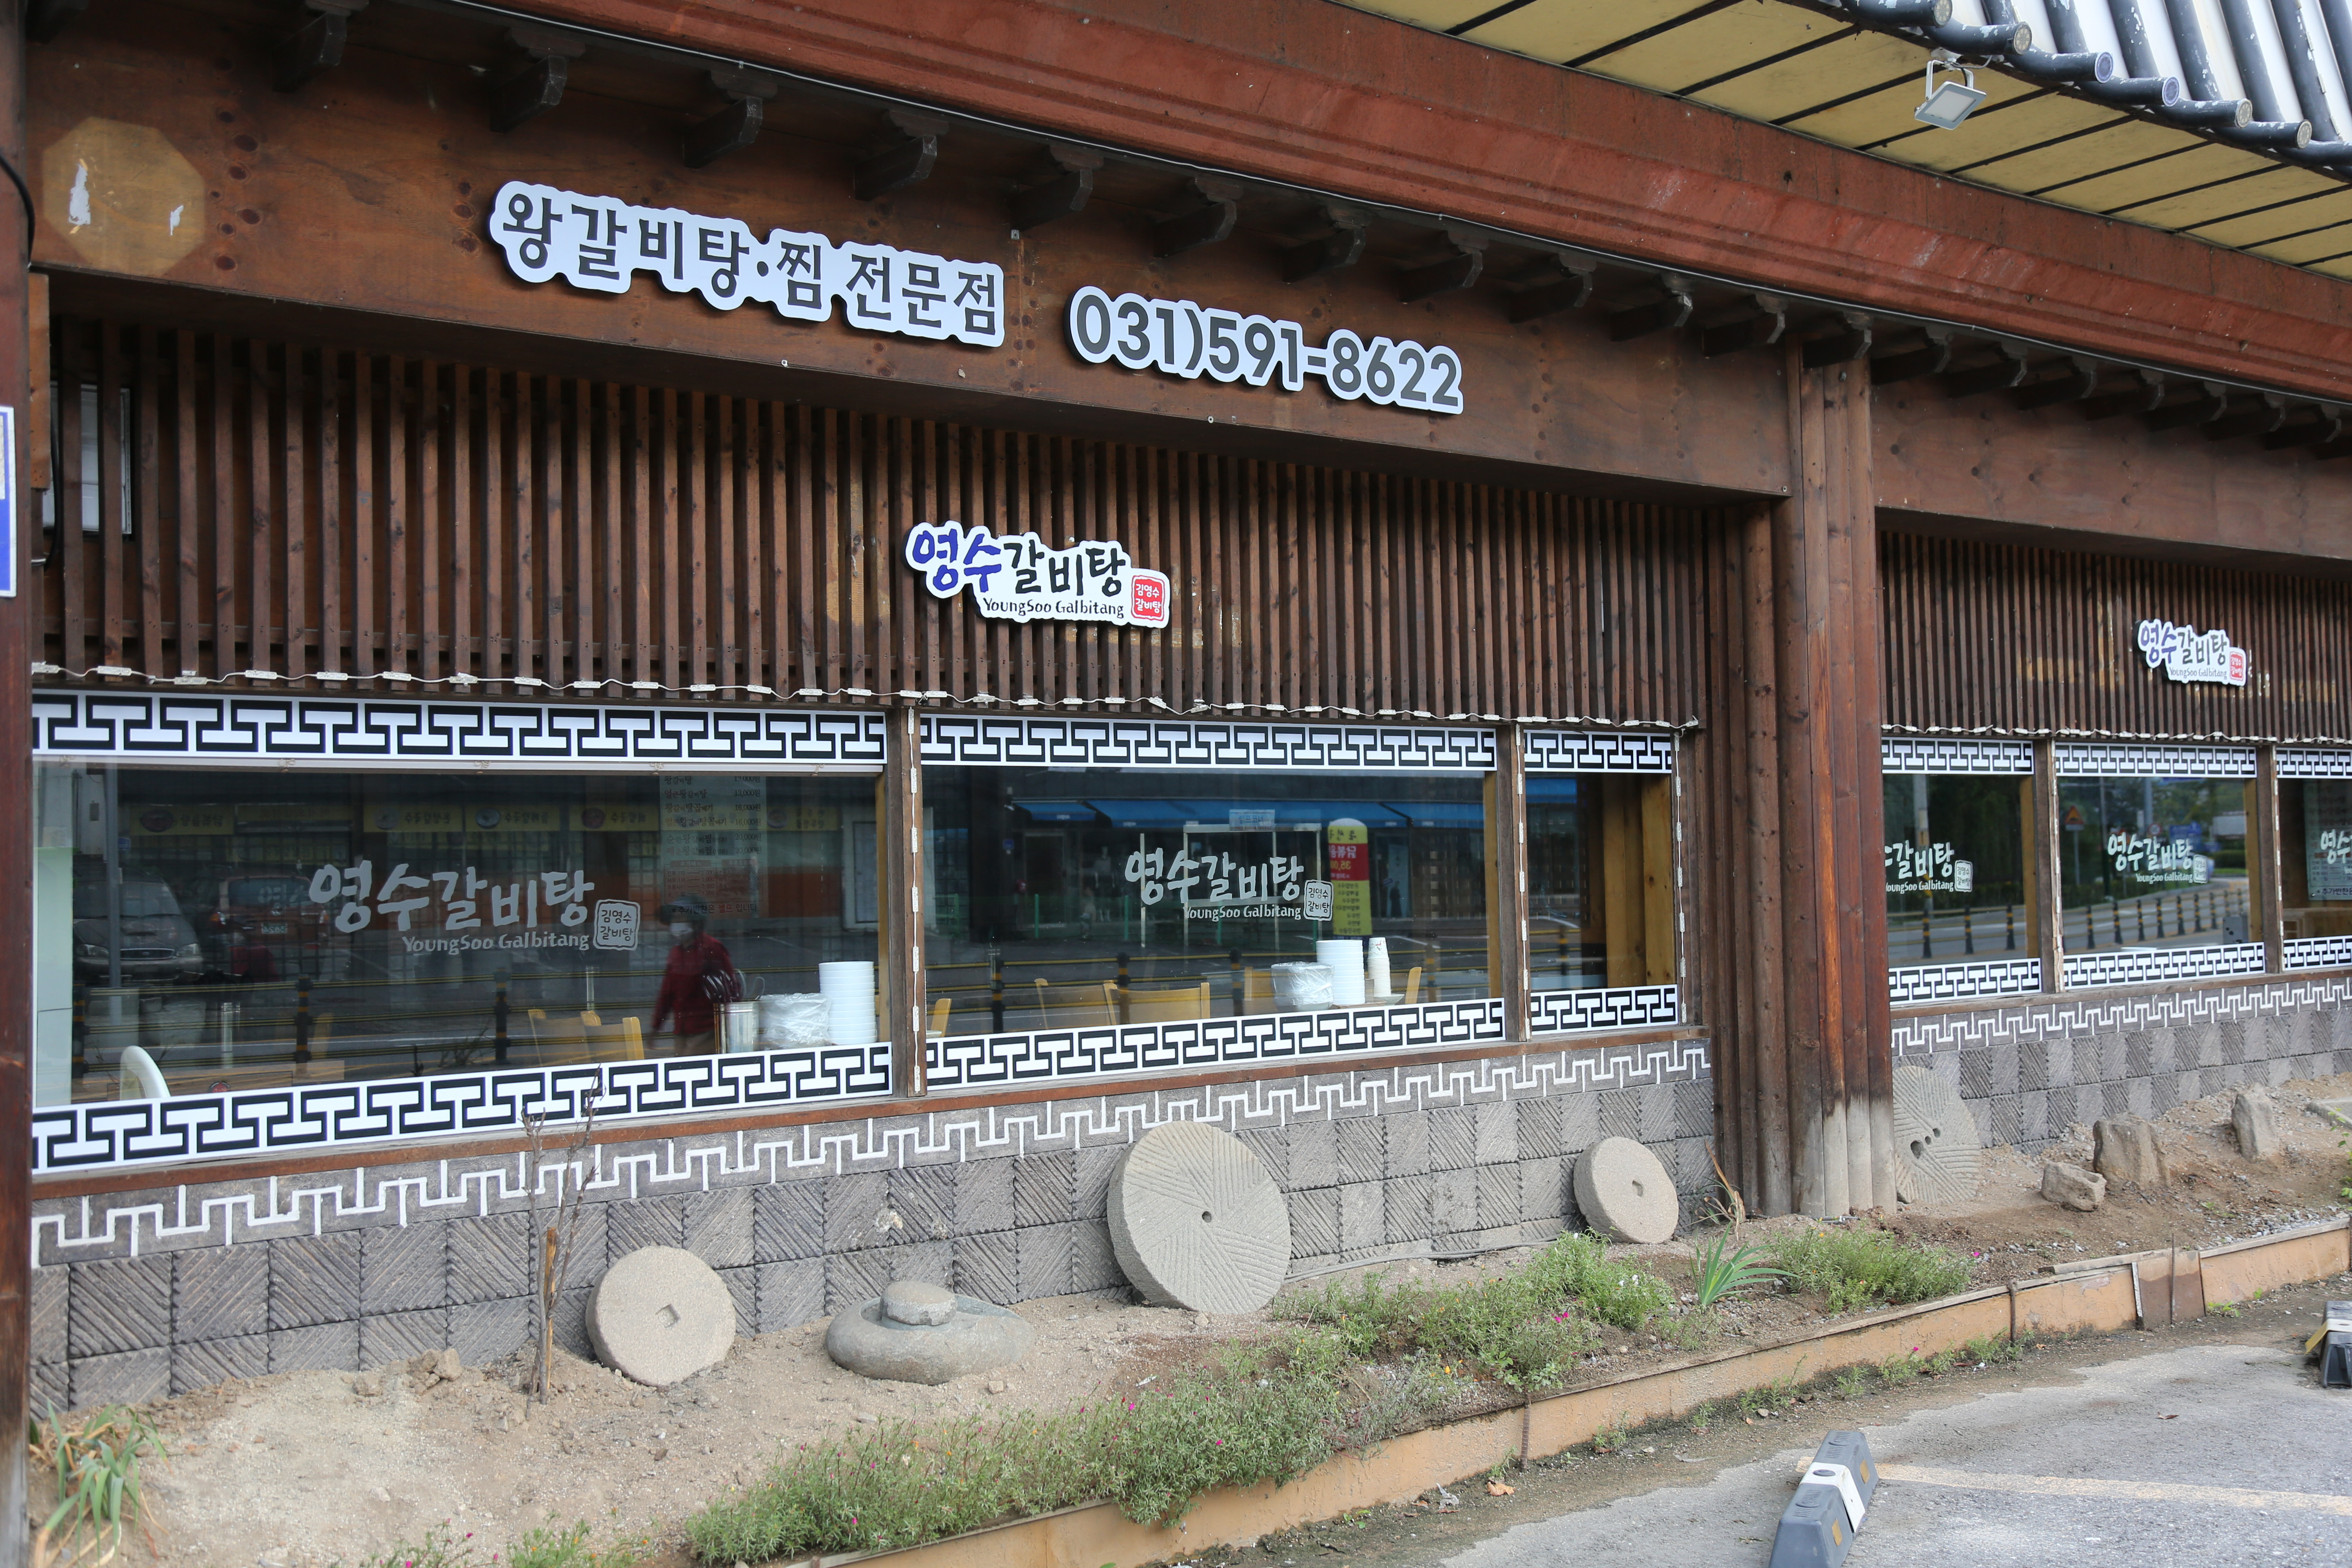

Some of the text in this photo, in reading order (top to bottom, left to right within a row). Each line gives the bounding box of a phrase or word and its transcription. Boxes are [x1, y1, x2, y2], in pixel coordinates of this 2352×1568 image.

[503, 194, 995, 335] 왕갈비탕·찜 전문점
[1077, 295, 1458, 406] 031)591-8622
[913, 529, 1125, 597] 영수갈비탕
[1136, 584, 1160, 597] 김영수
[983, 598, 1124, 619] YoungSoo Galbitang
[1135, 598, 1161, 614] 갈비탕
[2141, 624, 2227, 665] 영수갈비탕
[2169, 667, 2227, 679] YoungSoo Galbitang
[664, 776, 693, 785] 왕갈비탕
[665, 789, 761, 799] 얼큰왕갈비탕 13,000원
[735, 804, 761, 812] 16,000원
[2107, 832, 2194, 871] 영수갈비탕
[1125, 848, 1303, 905] 영수갈비탕
[1957, 866, 1970, 875] 김영수
[2136, 871, 2193, 884] YoungSoo Galbitang
[1919, 880, 1954, 892] Galbitang
[1957, 877, 1971, 886] 갈비탕
[310, 860, 595, 933] 영수갈비탕
[1308, 887, 1328, 899] 김영수
[718, 904, 733, 913] 셀프
[736, 903, 759, 913] 입니다.
[1185, 905, 1302, 922] YoungSoo Galbitang
[1308, 900, 1330, 913] 갈비탕
[601, 910, 632, 924] 김영수
[600, 926, 634, 942] 갈비탕
[403, 931, 589, 955] YoungSoo Galbitang
